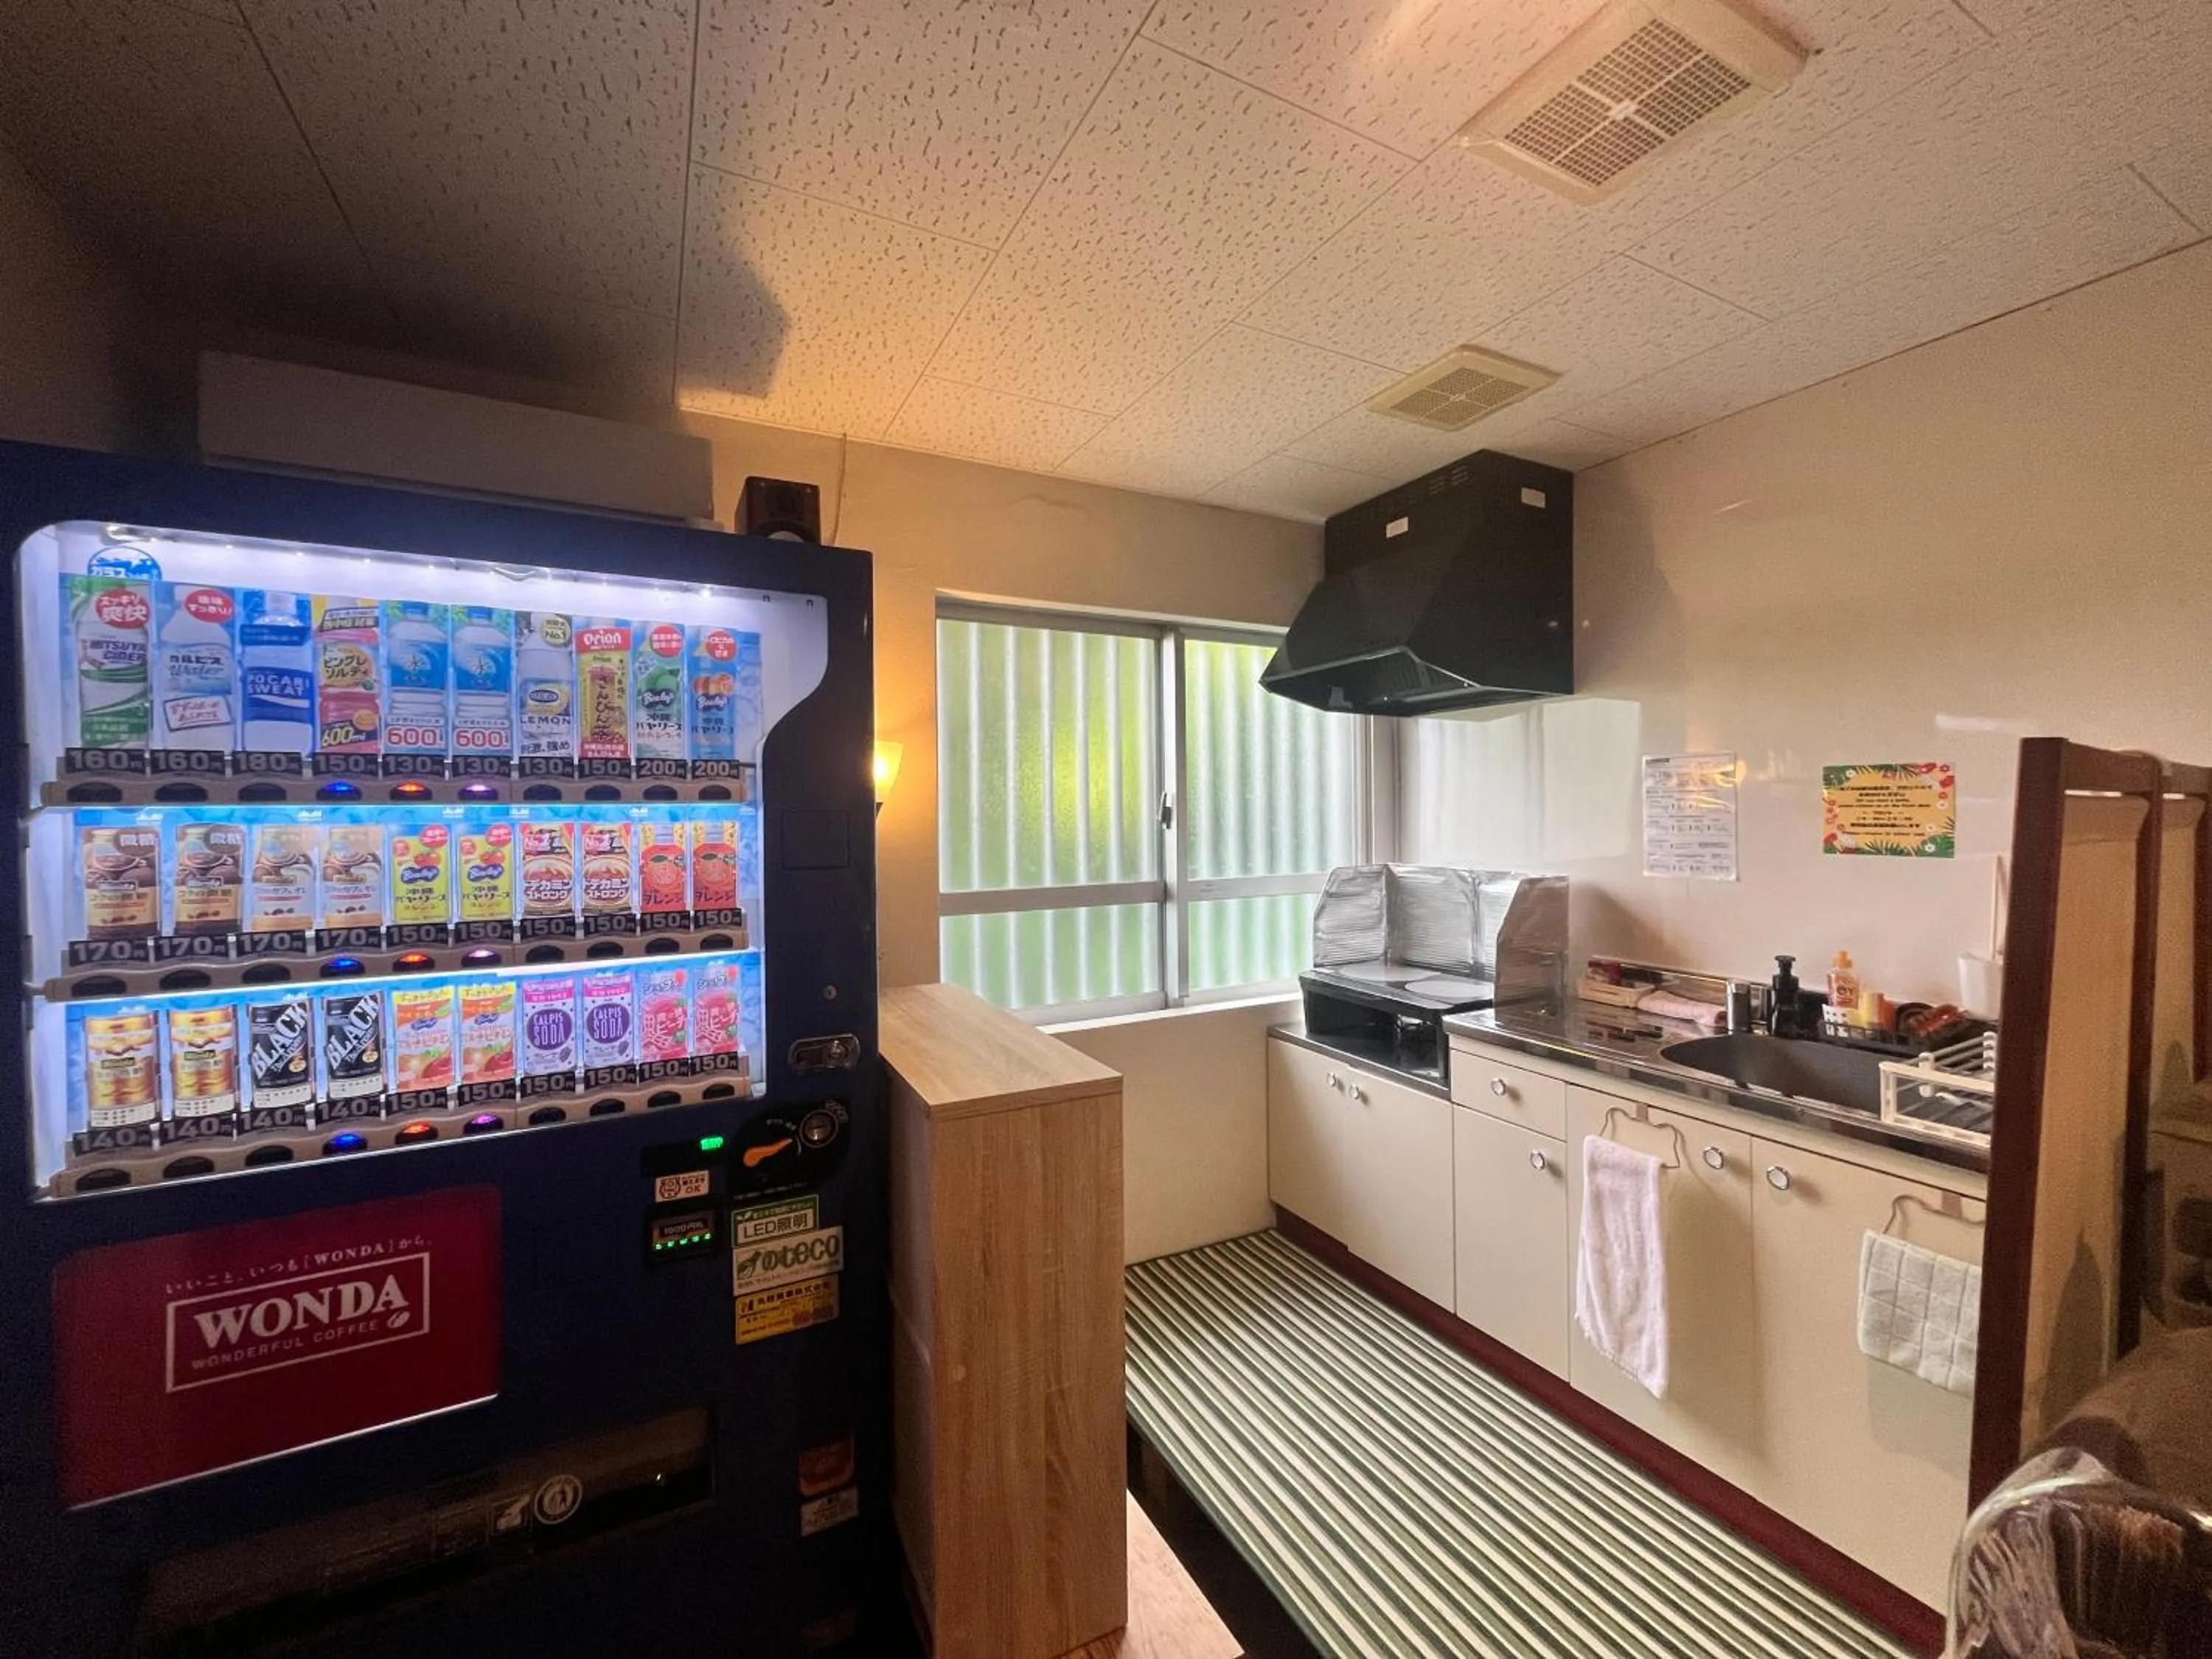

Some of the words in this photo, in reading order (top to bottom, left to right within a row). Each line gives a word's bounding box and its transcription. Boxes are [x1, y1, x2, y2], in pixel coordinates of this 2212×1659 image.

[246, 674, 310, 689] POCARI
[246, 684, 304, 696] SWEAT
[520, 716, 571, 725] LEMON
[533, 1012, 563, 1026] CALPIS
[594, 1006, 622, 1020] CALPIS
[327, 995, 380, 1070] BLACK
[533, 1023, 565, 1047] SODA
[594, 1018, 624, 1040] SODA
[251, 1001, 308, 1080] BLACK
[194, 1274, 410, 1349] WONDA
[191, 1337, 304, 1371] WONDERFUL
[313, 1321, 380, 1343] COFFEE
